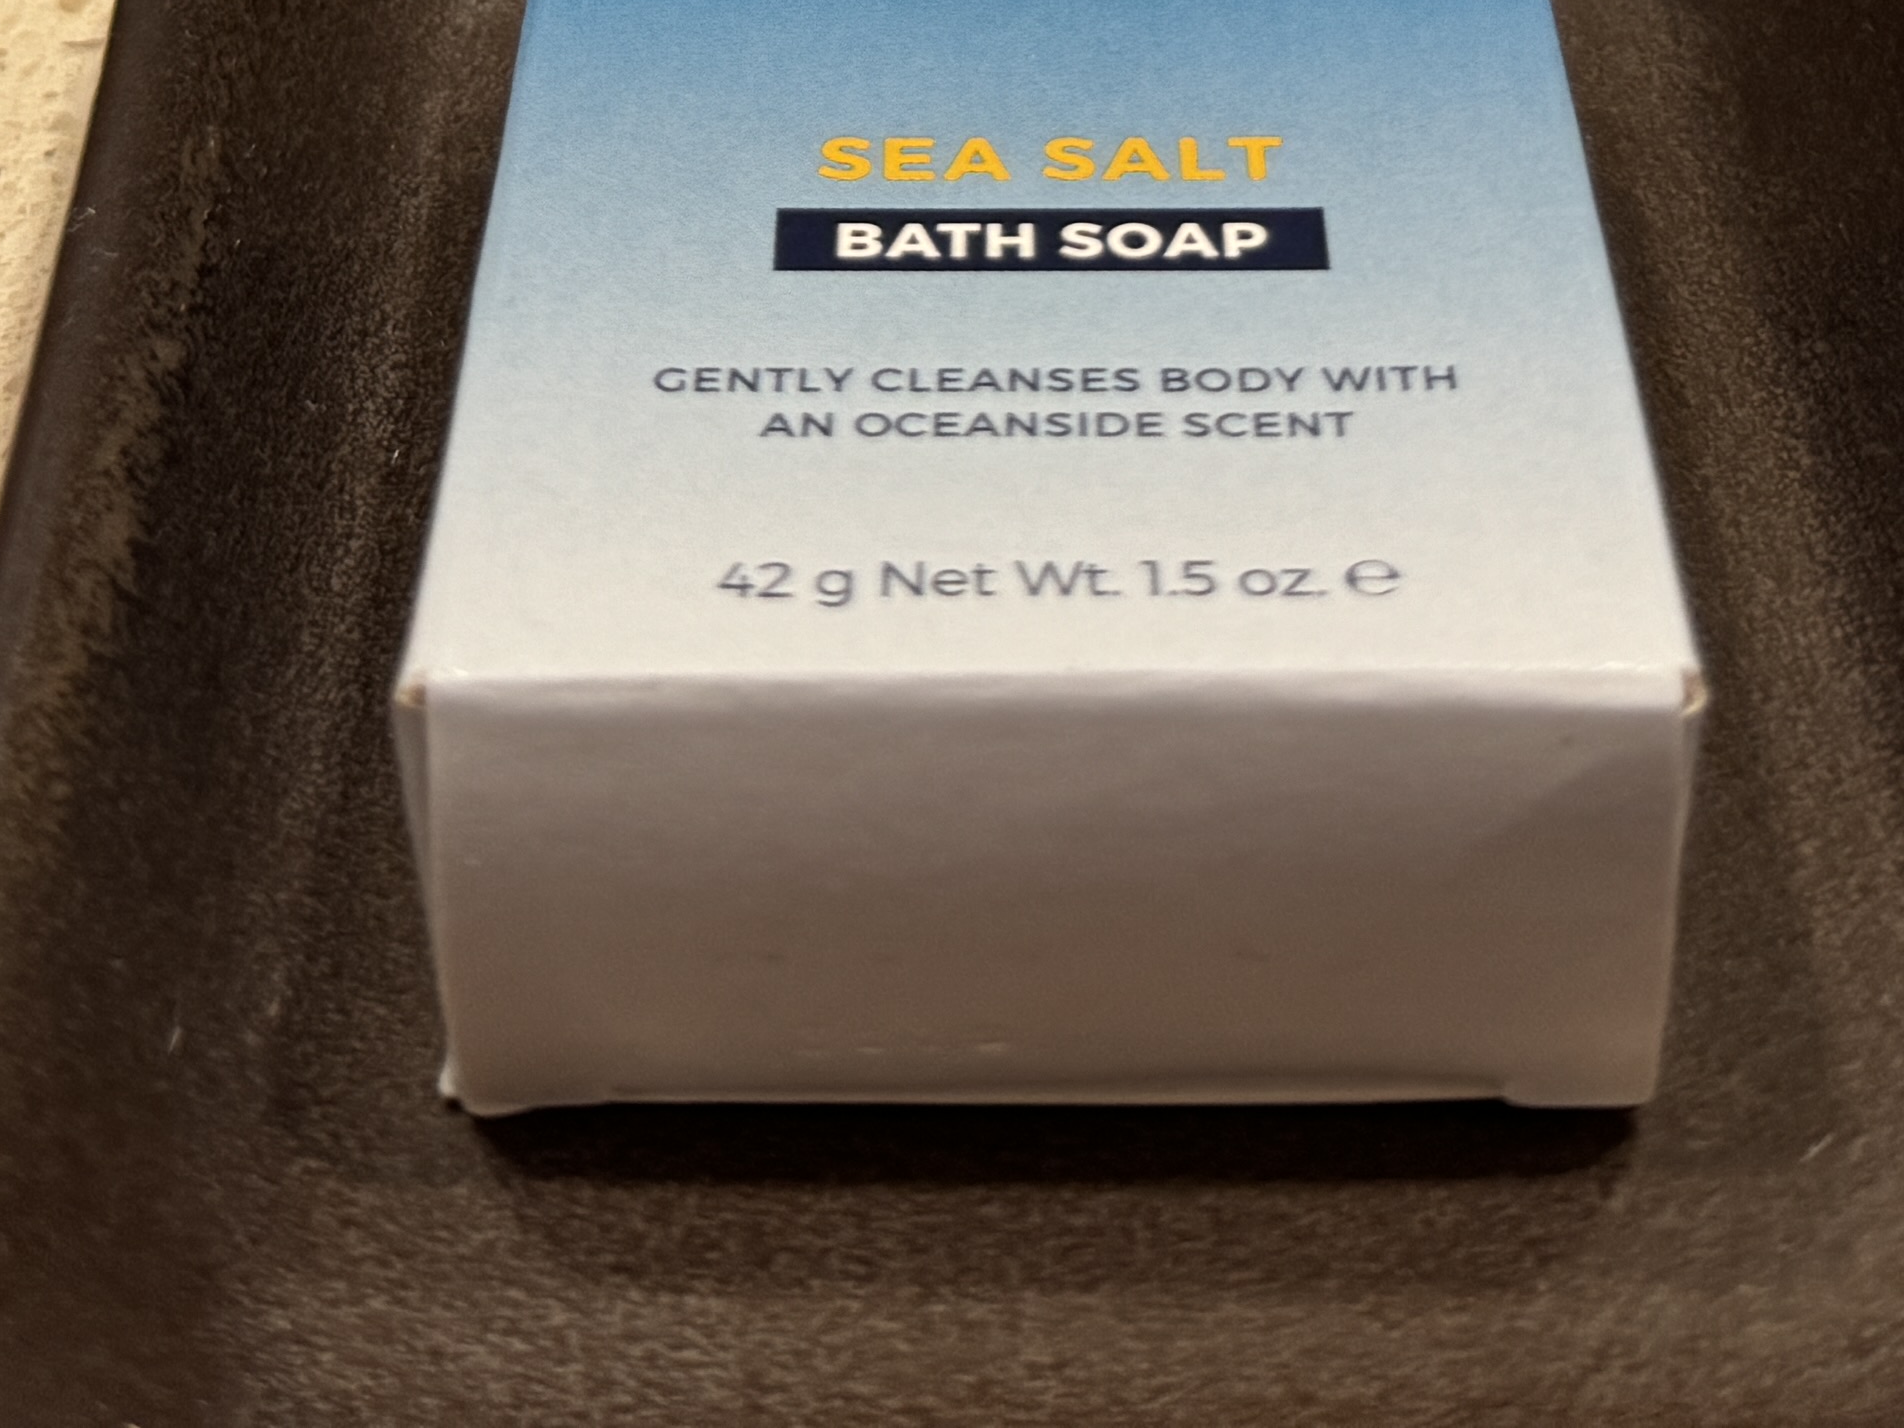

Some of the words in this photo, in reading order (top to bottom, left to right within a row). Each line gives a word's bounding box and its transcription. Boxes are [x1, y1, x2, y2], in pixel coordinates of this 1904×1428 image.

[816, 135, 1013, 183] SEA
[1041, 135, 1285, 183] SALT
[834, 220, 1037, 261] BATH
[1058, 220, 1270, 261] SOAP
[651, 365, 855, 395] GENTLY
[869, 365, 1142, 395] CLEANSES
[1158, 365, 1306, 395] BODY
[1319, 363, 1459, 394] WITH
[757, 410, 836, 439] AN
[852, 410, 1166, 439] OCEANSIDE
[1180, 409, 1356, 439] SCENT
[714, 560, 796, 600] 42
[812, 568, 858, 610] g
[878, 559, 1000, 599] Net
[1011, 558, 1124, 599] Wt.
[1136, 558, 1221, 599] 1.5
[1235, 566, 1331, 600] oz.
